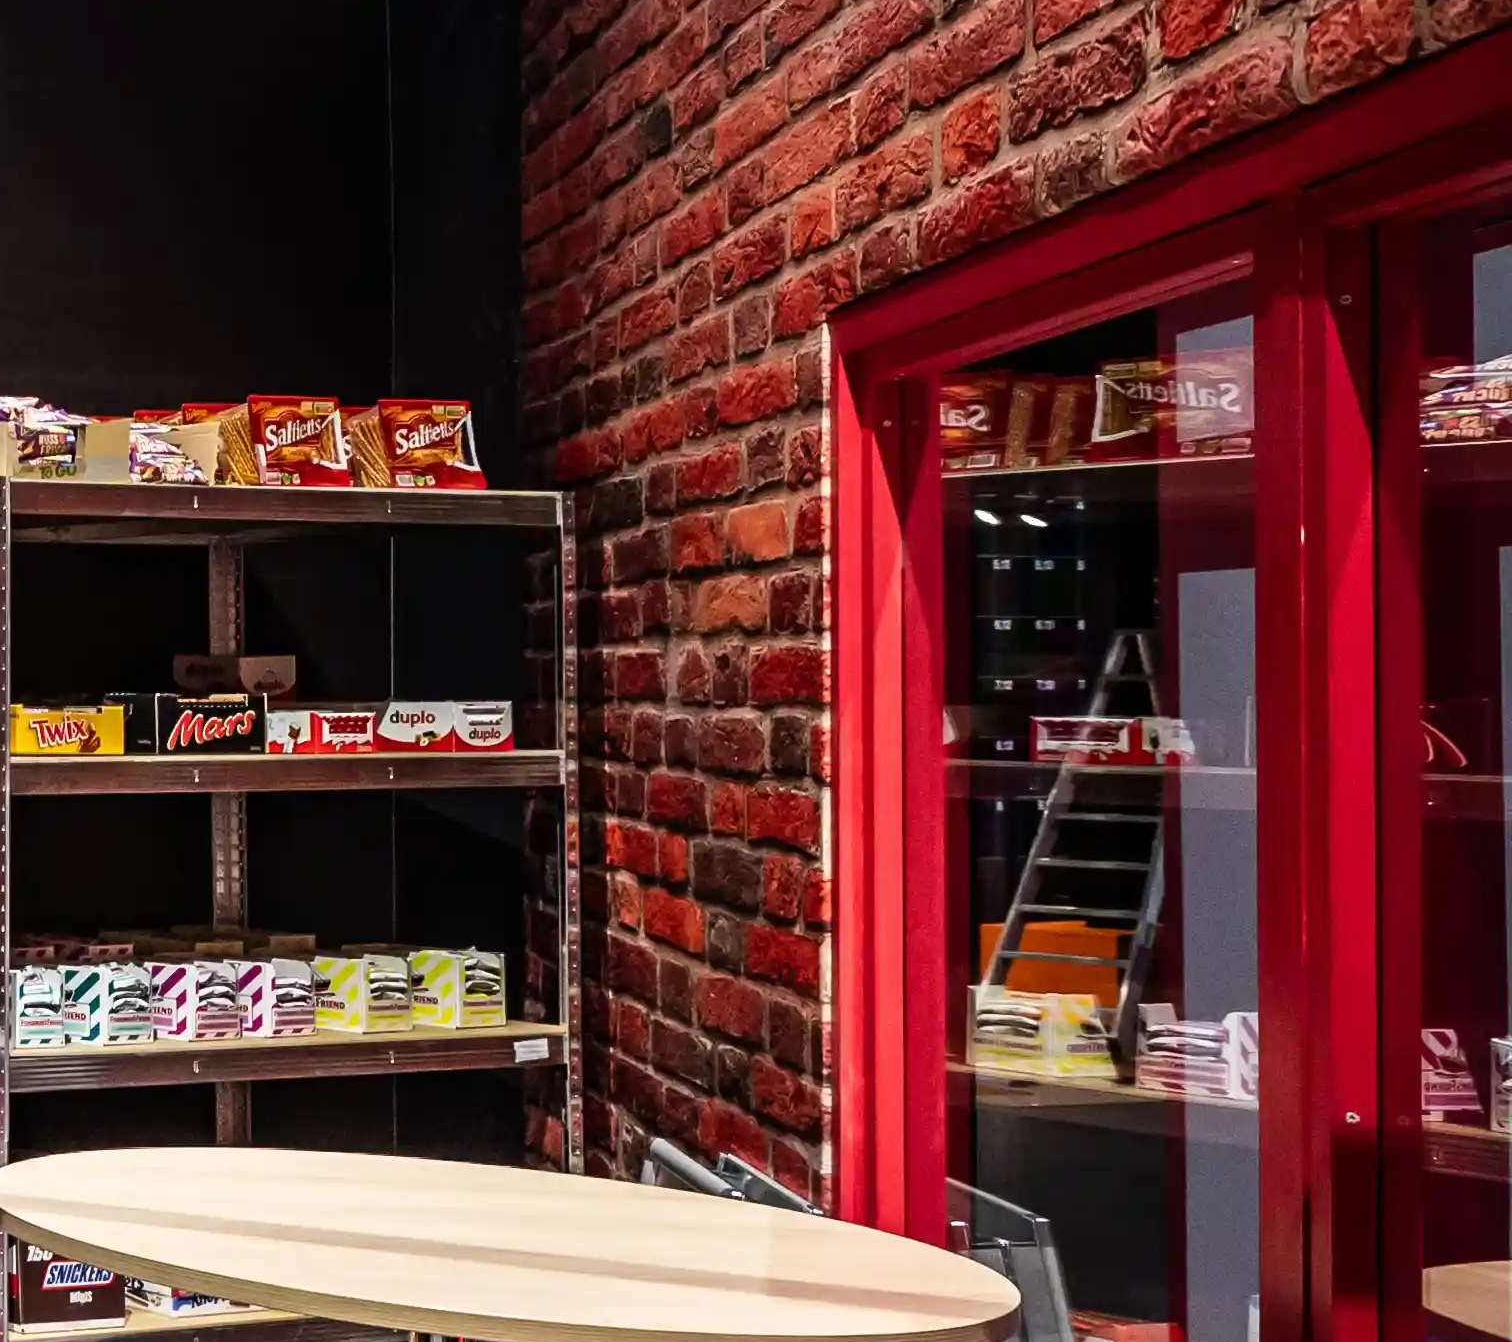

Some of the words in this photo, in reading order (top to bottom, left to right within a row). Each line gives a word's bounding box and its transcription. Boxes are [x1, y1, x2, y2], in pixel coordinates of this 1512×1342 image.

[390, 710, 435, 729] duplo
[167, 710, 256, 751] Mars
[469, 727, 501, 743] duplo
[47, 1264, 113, 1285] SNICKERS
